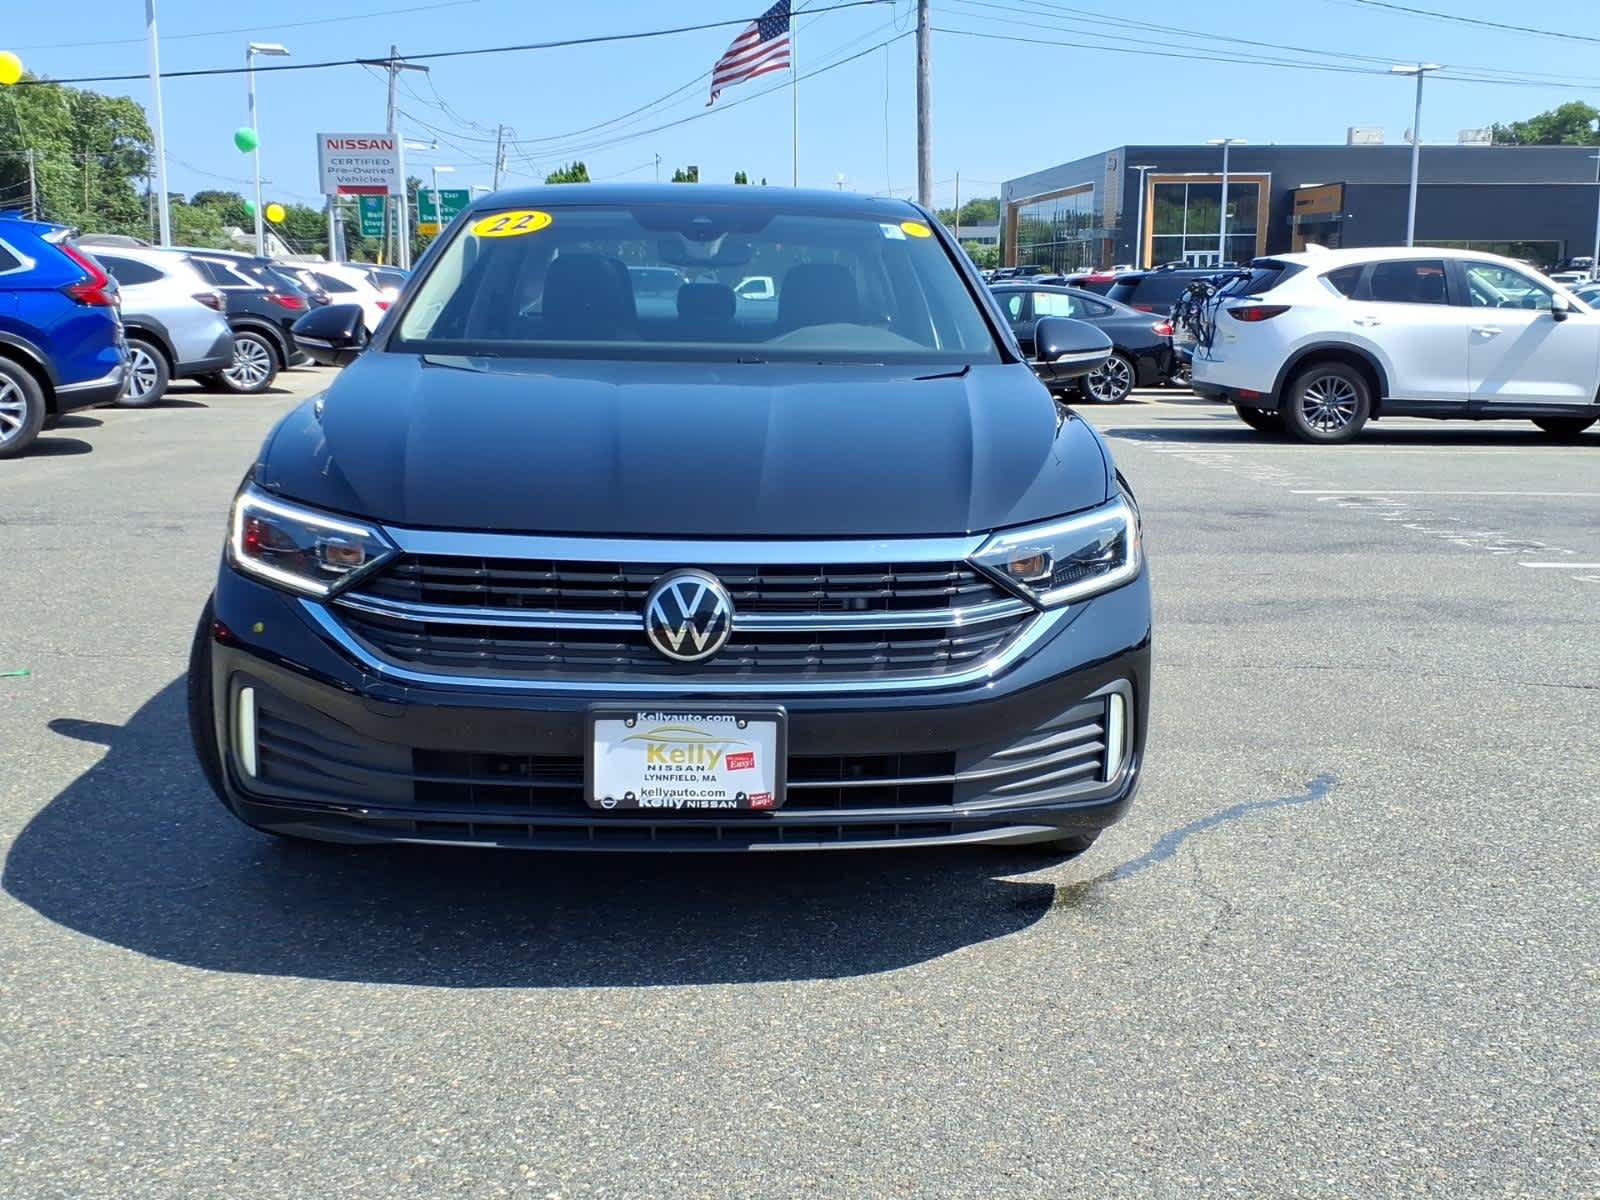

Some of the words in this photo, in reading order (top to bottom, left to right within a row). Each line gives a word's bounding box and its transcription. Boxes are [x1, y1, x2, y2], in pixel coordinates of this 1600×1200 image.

[327, 139, 393, 150] NISSAN
[331, 158, 390, 166] CERTIFIED
[337, 175, 386, 183] Vehicles
[487, 214, 535, 233] 22
[637, 712, 736, 723] Kellyauto.com
[646, 743, 723, 770] Kelly
[644, 774, 700, 783] LYNNFIELD,
[640, 787, 726, 798] kellyauto.com
[638, 799, 685, 809] Kelly
[686, 800, 737, 809] NISSAN
